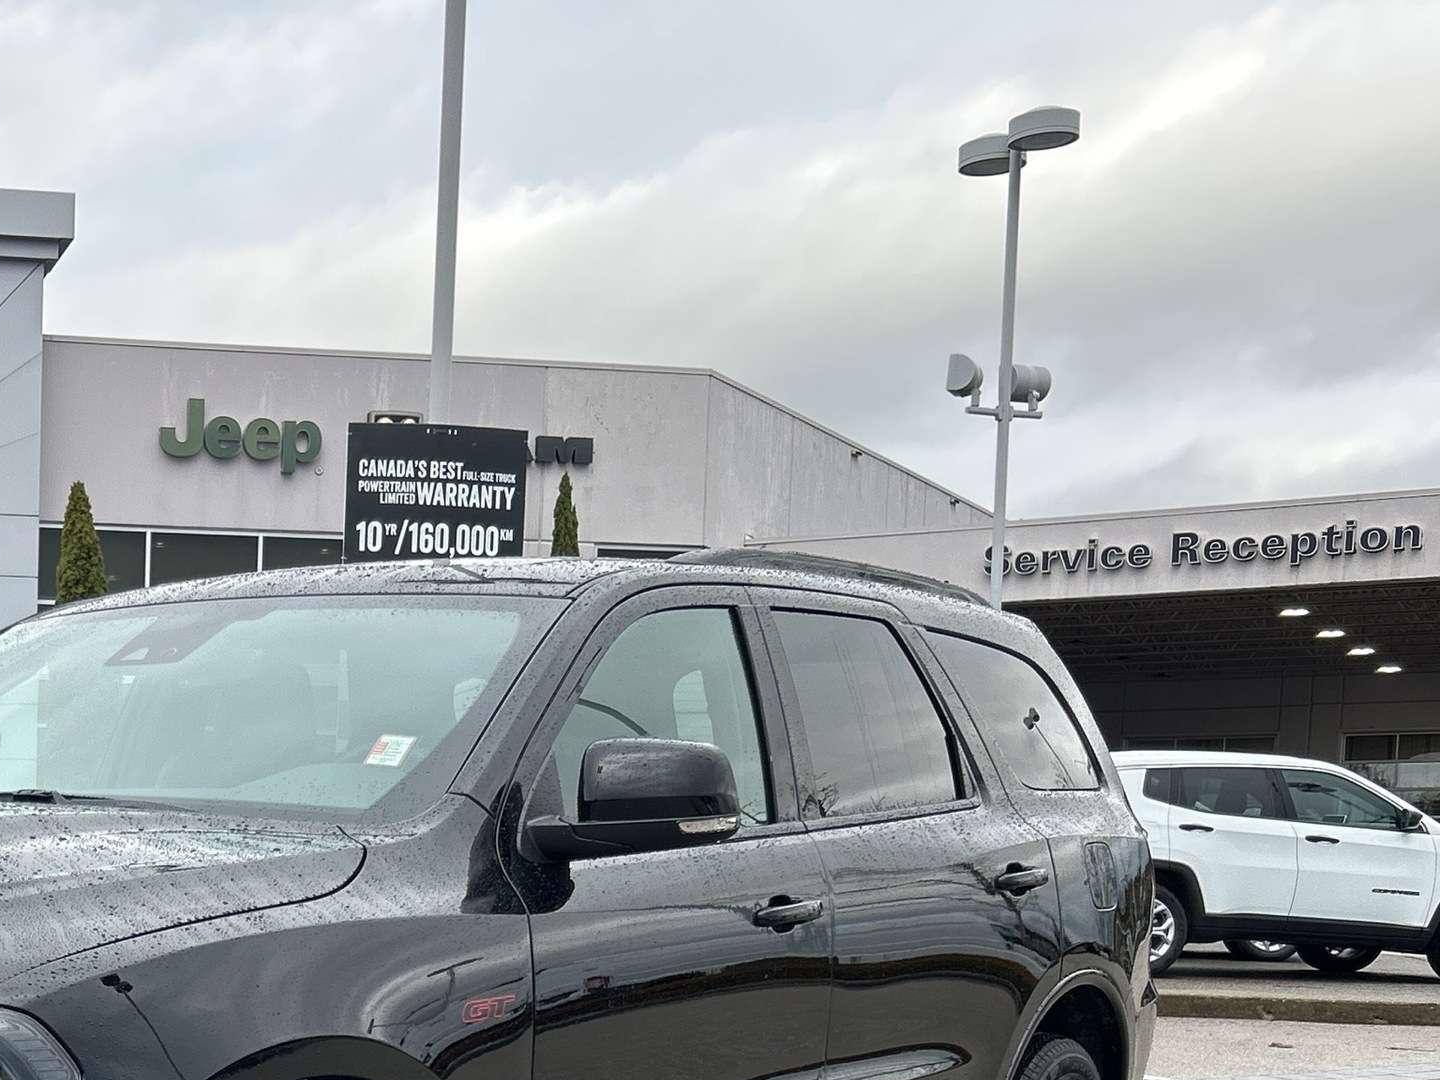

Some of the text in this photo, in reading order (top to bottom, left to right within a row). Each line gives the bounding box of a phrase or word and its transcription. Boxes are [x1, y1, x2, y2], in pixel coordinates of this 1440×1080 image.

[159, 397, 323, 476] Jeep
[358, 459, 464, 480] CANADA'S BEST
[462, 470, 517, 484] FULL-SIZE TRUCK
[358, 480, 416, 493] POWERTRAIN
[379, 493, 416, 505] LIMITED
[416, 481, 516, 510] WARRANTY
[983, 520, 1424, 578] Service Reception
[462, 993, 517, 1024] GT
